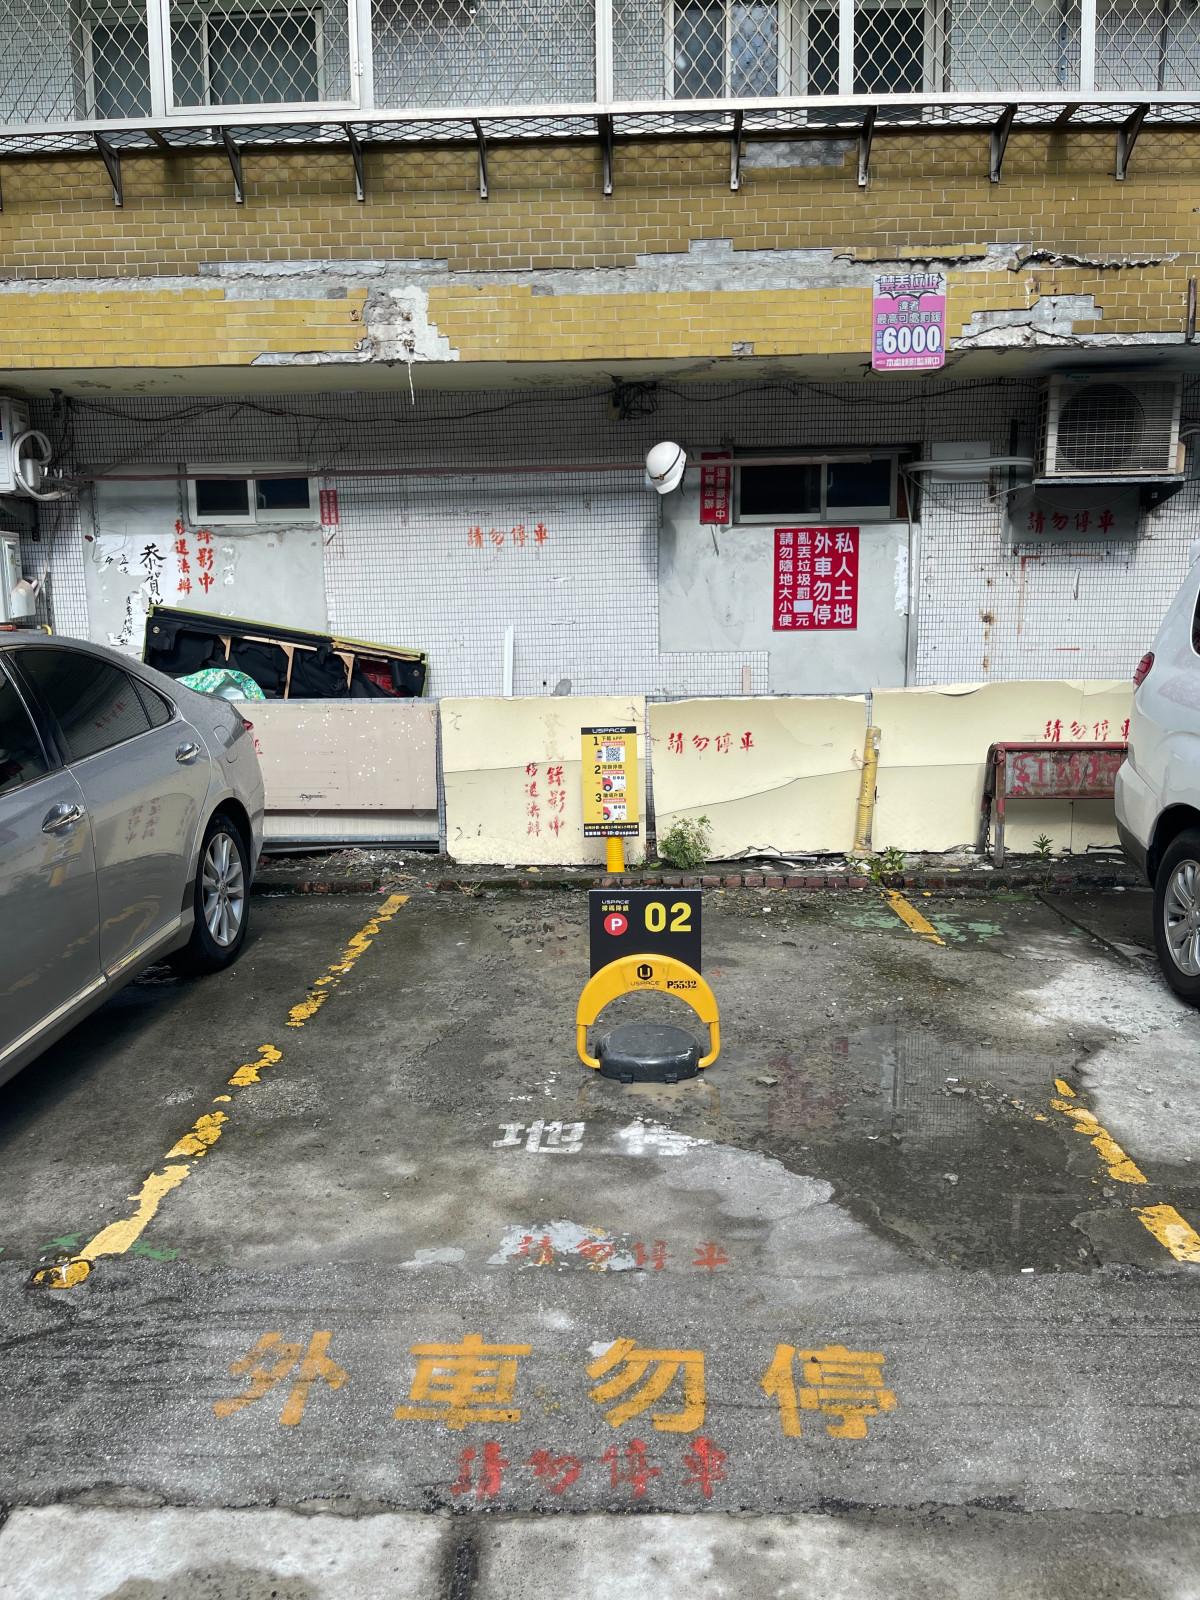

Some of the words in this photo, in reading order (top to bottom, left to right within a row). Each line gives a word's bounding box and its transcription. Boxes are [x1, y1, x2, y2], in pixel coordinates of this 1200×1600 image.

[883, 325, 941, 354] 6000
[1027, 508, 1115, 534] 請勿停車
[466, 521, 549, 548] 請勿停車
[778, 532, 793, 626] 請勿隨地大小便
[812, 532, 832, 625] 外車勿停
[834, 532, 854, 625] 私人土地
[593, 736, 599, 745] 1
[667, 731, 754, 754] 請勿停車
[594, 765, 601, 774] 2
[595, 793, 602, 802] 3
[611, 918, 622, 931] P
[645, 902, 692, 932] 02
[666, 980, 697, 989] P5532
[212, 1329, 898, 1440] 外車勿停
